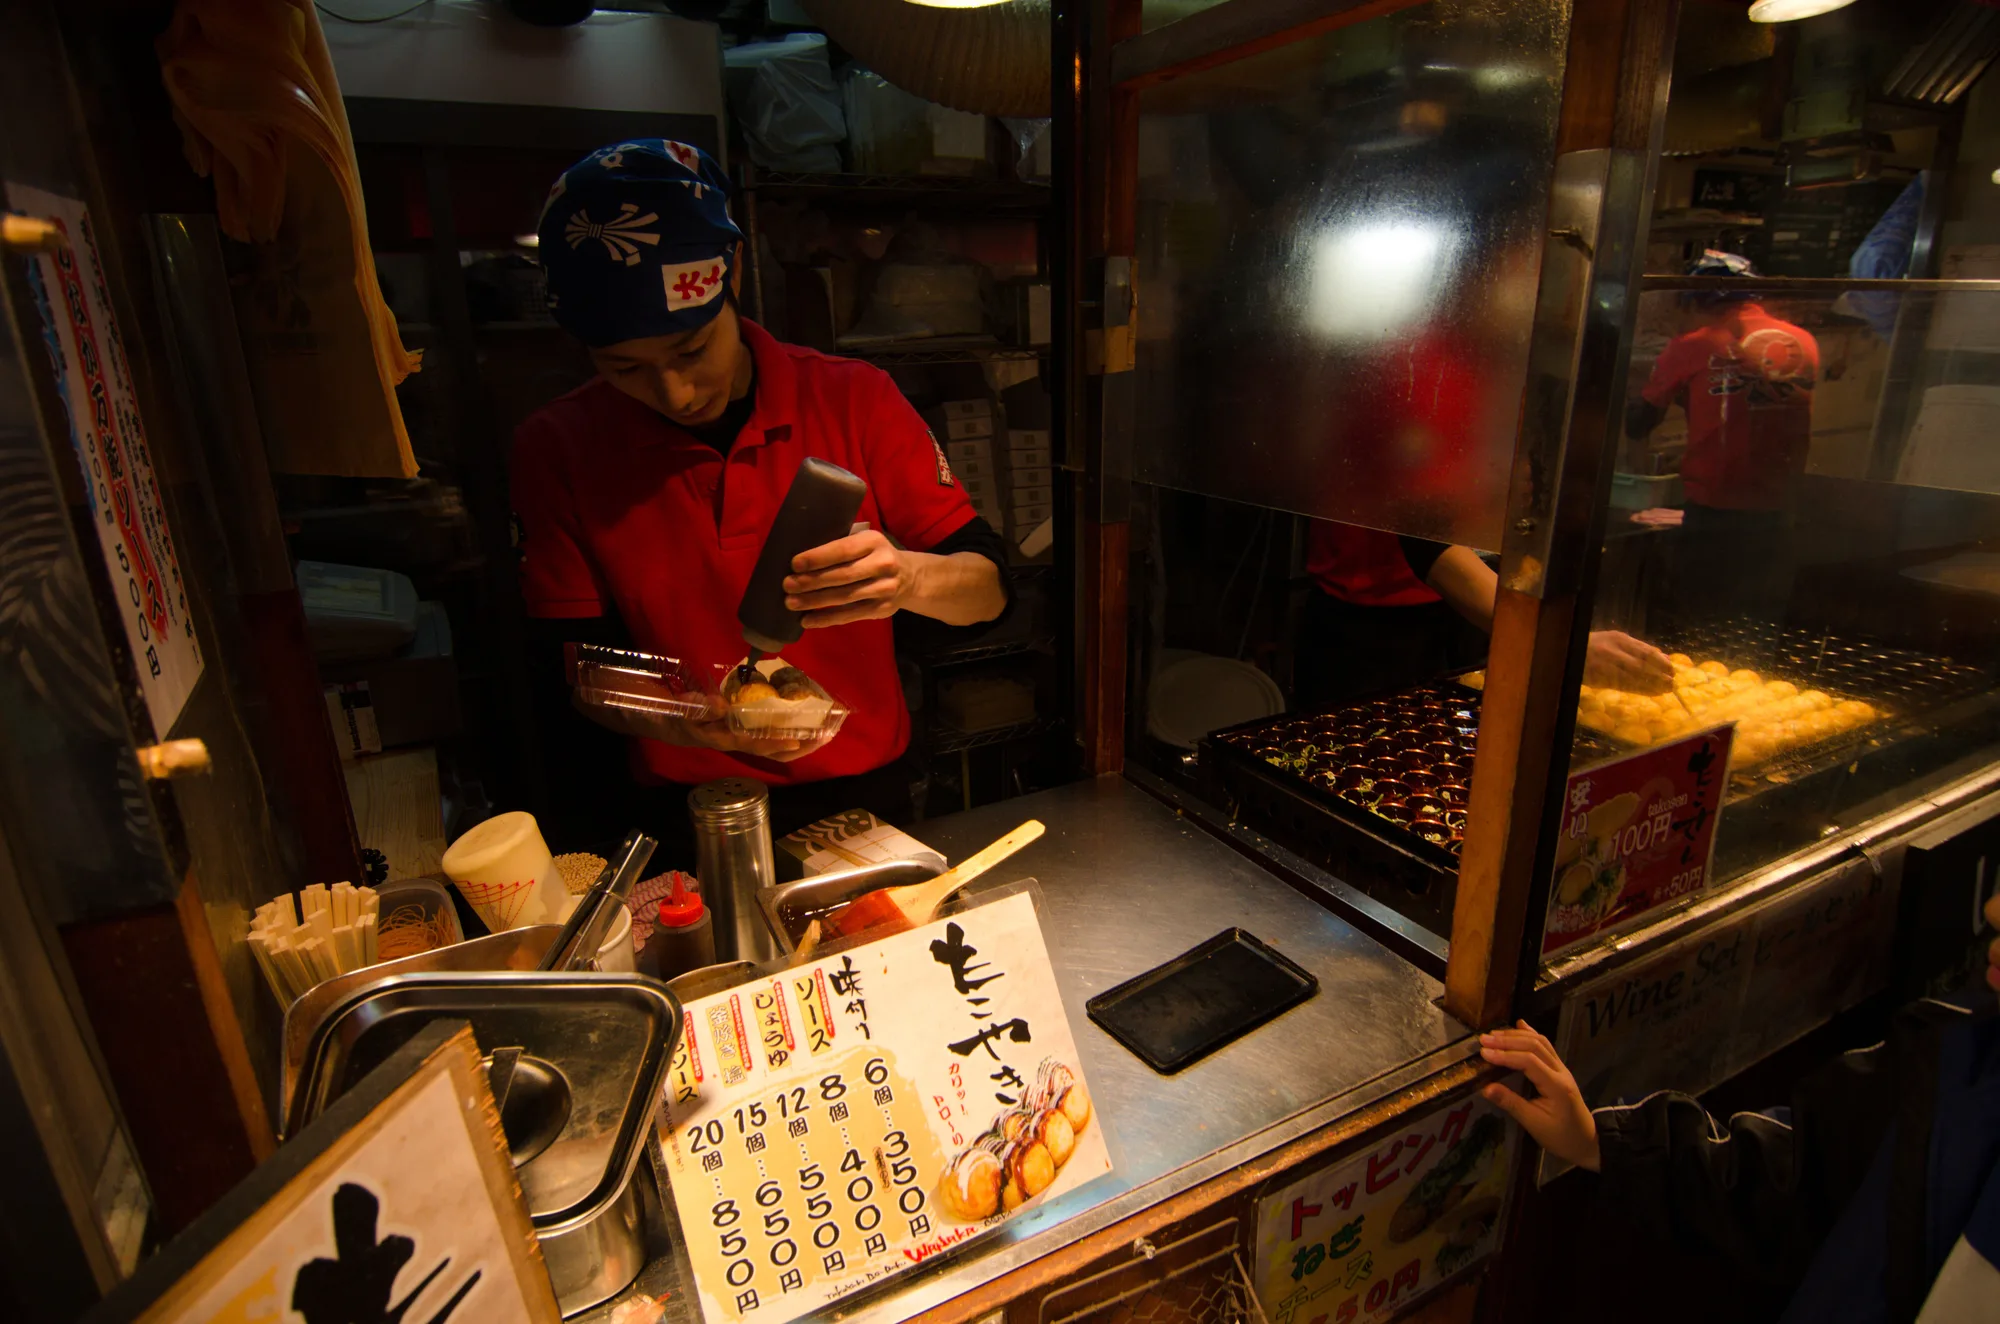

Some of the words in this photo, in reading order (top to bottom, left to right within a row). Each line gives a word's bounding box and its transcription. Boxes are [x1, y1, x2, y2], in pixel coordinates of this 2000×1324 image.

[116, 542, 162, 681] 500円
[1612, 811, 1673, 861] 100円
[755, 992, 789, 1067] しょうゆ
[796, 977, 832, 1052] ソース
[1585, 970, 1686, 1039] Wine
[1696, 932, 1741, 979] Set
[687, 1119, 724, 1173] 20個
[711, 1200, 760, 1314] 850円
[733, 1102, 767, 1155] 15個
[755, 1180, 803, 1294] 650円
[776, 1087, 810, 1138] 12個
[798, 1165, 846, 1275] 550円
[819, 1075, 848, 1123] 8個
[840, 1149, 887, 1257] 400円
[864, 1058, 893, 1107] 6個
[883, 1131, 931, 1238] 350円
[1291, 1101, 1474, 1241] トッピング
[1276, 1251, 1373, 1324] チーズ
[1291, 1214, 1365, 1281] ねぎ
